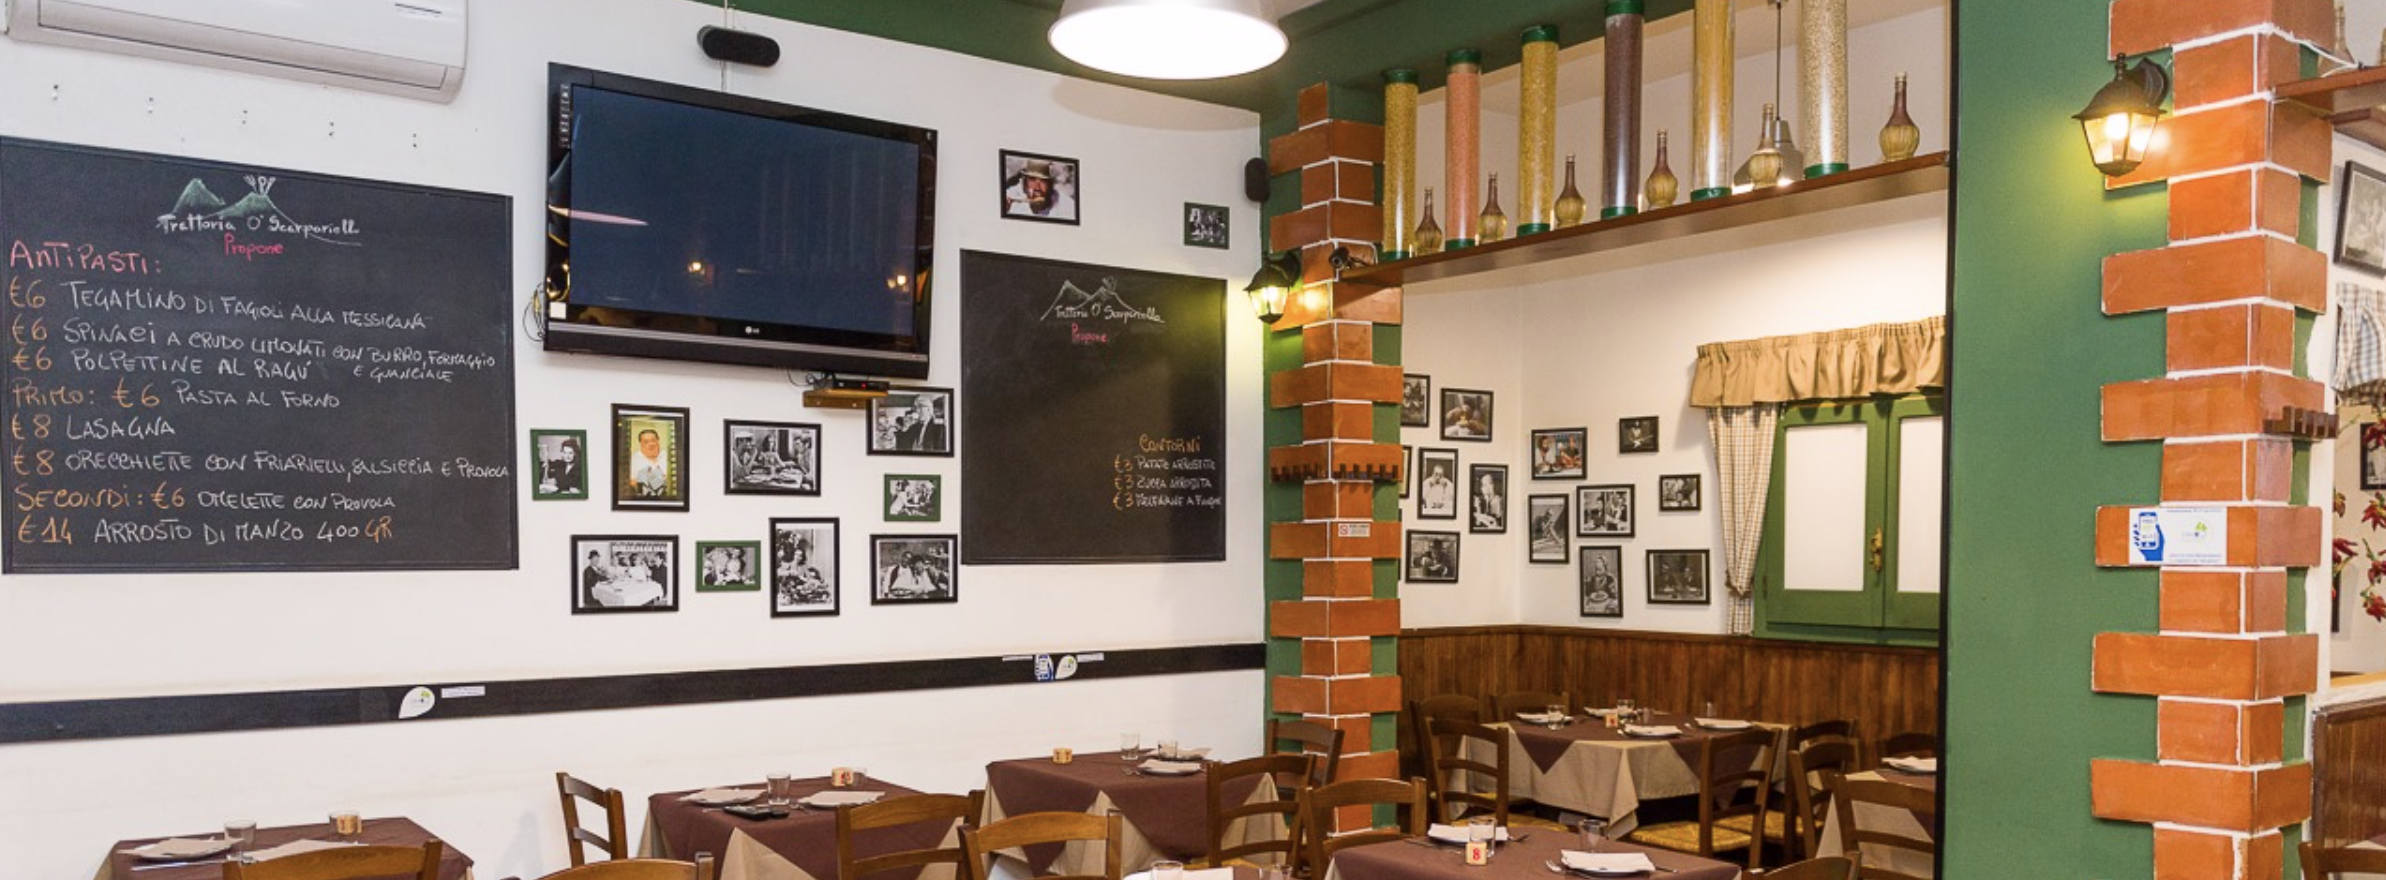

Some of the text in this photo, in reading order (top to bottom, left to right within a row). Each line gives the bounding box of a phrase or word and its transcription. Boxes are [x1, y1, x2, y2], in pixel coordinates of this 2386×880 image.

[224, 232, 284, 260] Propone
[194, 296, 214, 315] DI
[167, 331, 182, 346] A
[70, 349, 203, 375] POLPETTINE
[218, 358, 246, 376] AL
[171, 379, 238, 405] PASTA
[246, 392, 272, 407] AL
[66, 414, 176, 440] LASAGNA
[1139, 433, 1201, 453] CONTORNI
[441, 463, 453, 477] E
[330, 492, 396, 512] PROVOLA
[93, 517, 193, 543] ARROSTO
[203, 522, 226, 546] DI
[316, 519, 360, 543] 400
[1472, 847, 1481, 861] 8
